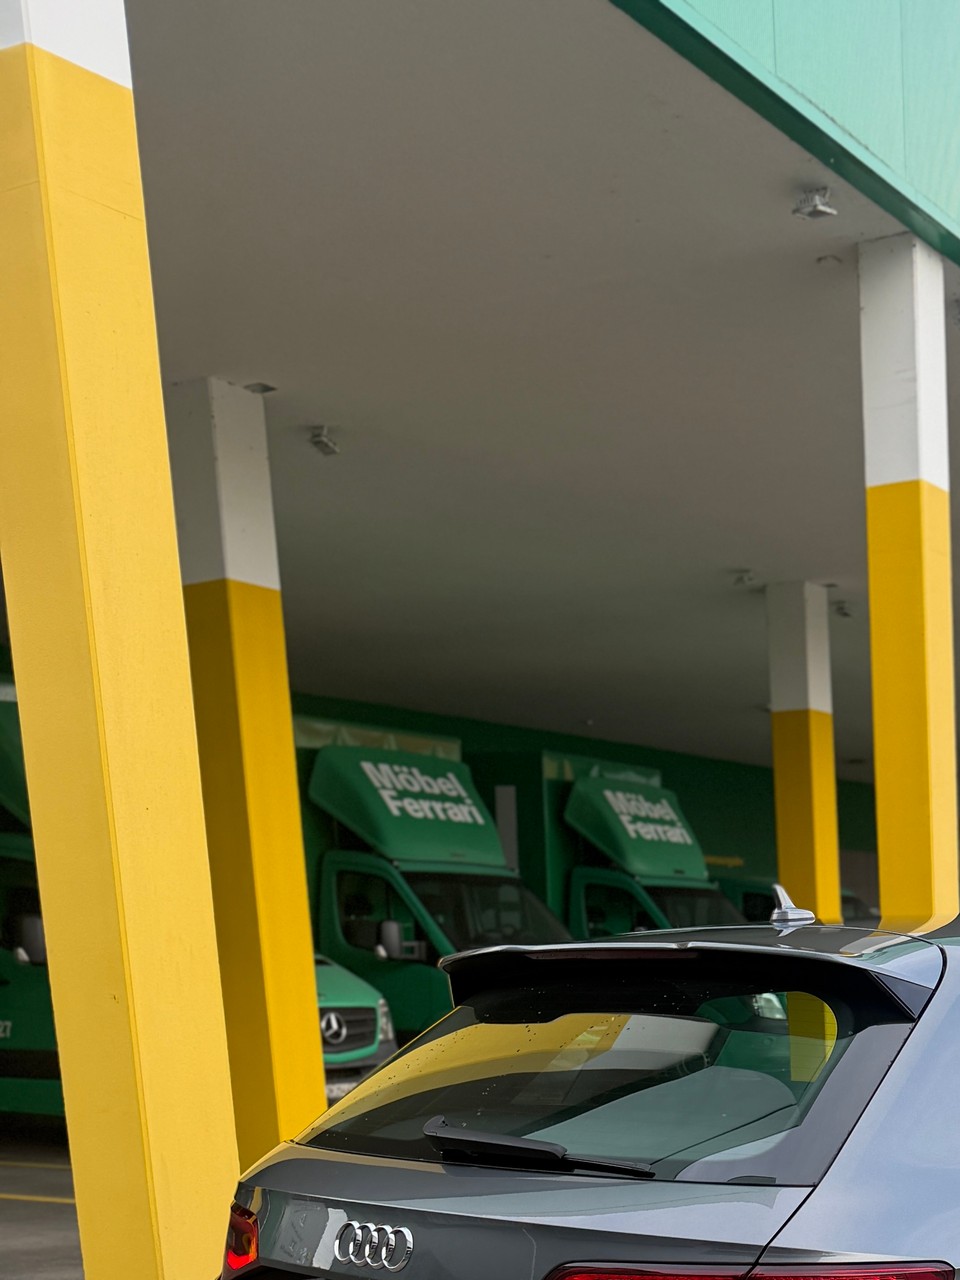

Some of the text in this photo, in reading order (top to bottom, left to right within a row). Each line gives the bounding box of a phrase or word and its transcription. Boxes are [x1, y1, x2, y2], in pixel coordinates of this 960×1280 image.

[359, 760, 468, 798] Möbel
[380, 789, 485, 825] Ferrari
[603, 789, 678, 824] Möbel
[618, 813, 694, 846] Ferrari
